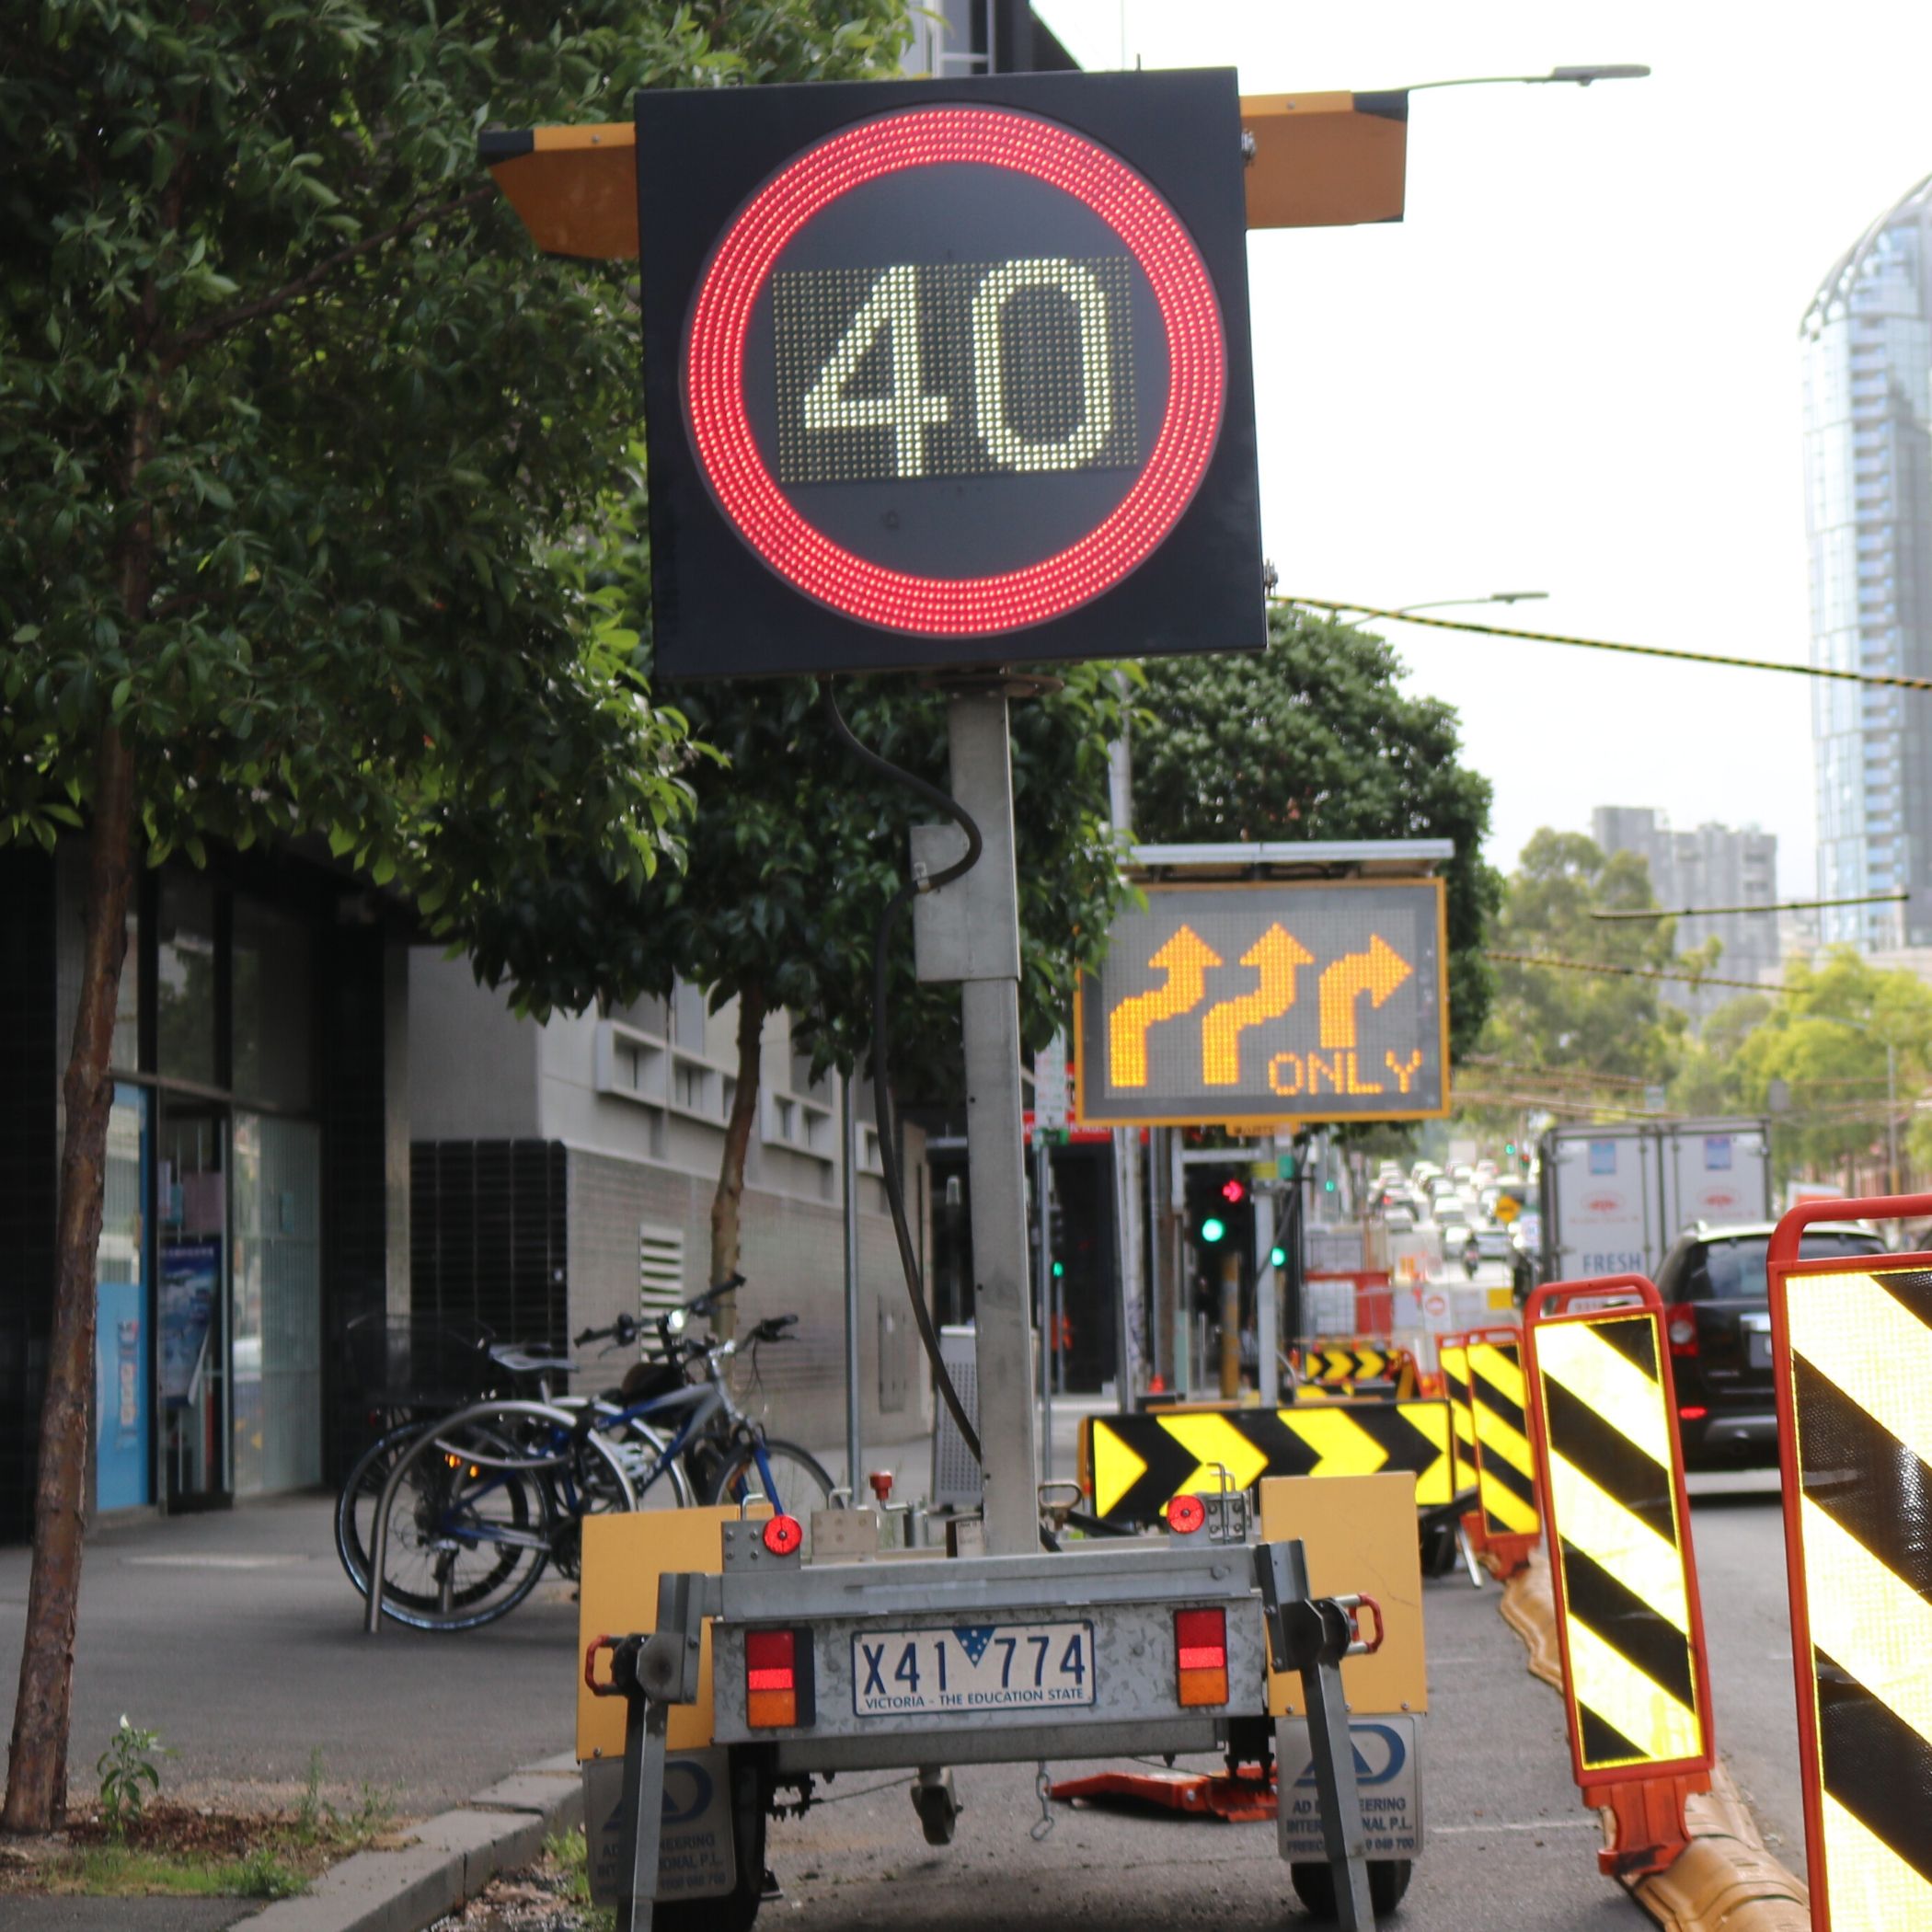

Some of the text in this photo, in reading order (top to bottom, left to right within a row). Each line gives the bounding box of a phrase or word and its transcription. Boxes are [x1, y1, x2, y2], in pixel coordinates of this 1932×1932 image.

[804, 259, 1110, 477] 40
[1267, 1048, 1423, 1097] ONLY
[1582, 1253, 1641, 1273] FRESH
[861, 1634, 1086, 1696] X41 774
[866, 1696, 926, 1710] VICTORIA
[939, 1694, 963, 1707] THE
[967, 1689, 1045, 1705] EDUCATION
[1047, 1687, 1085, 1701] STATE
[1293, 1800, 1312, 1813] AD
